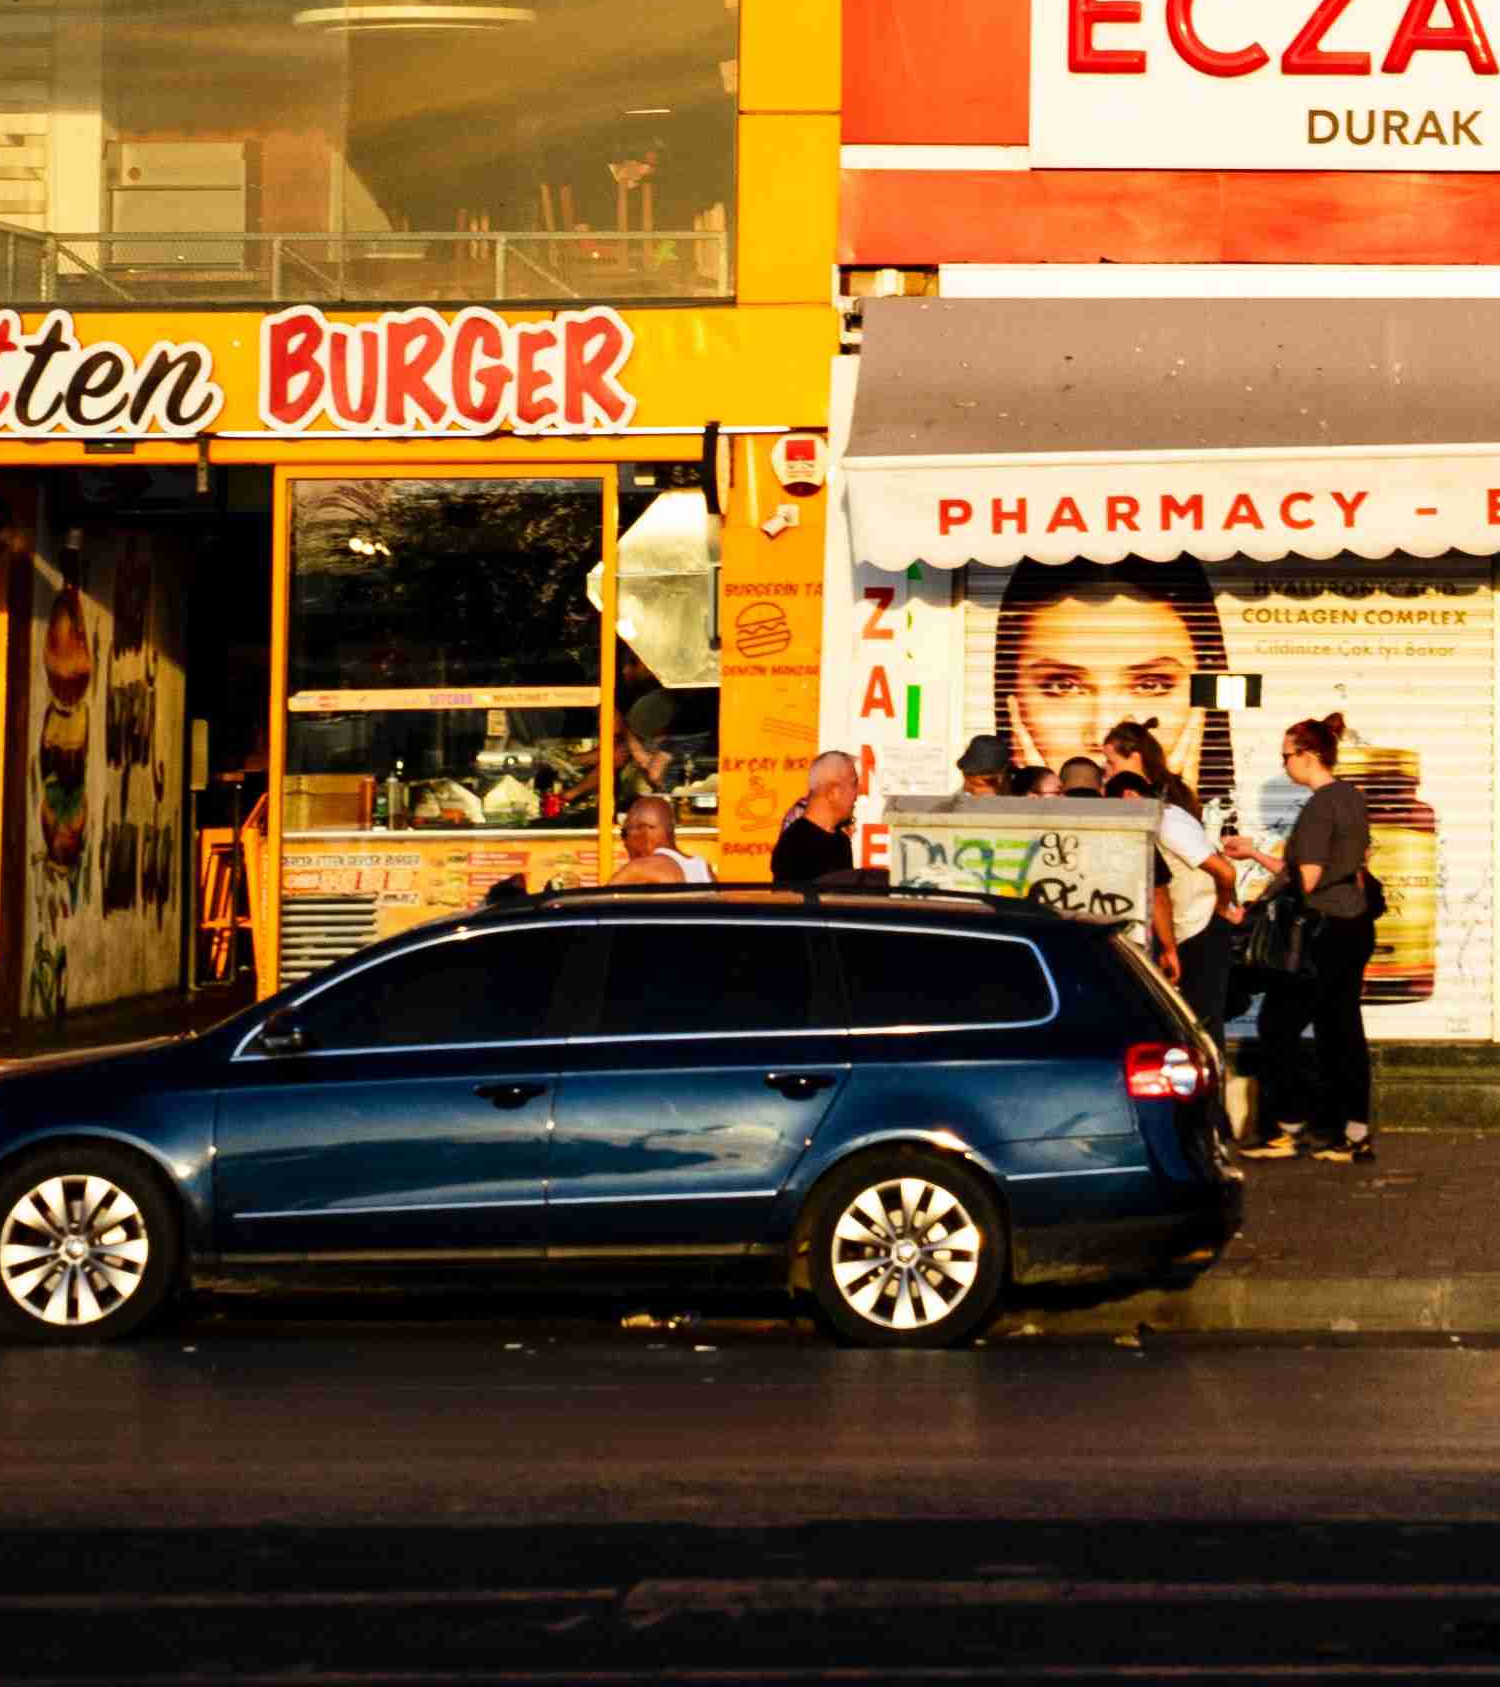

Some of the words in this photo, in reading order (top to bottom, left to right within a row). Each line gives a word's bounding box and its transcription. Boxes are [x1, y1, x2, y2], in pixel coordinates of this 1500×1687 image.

[1306, 108, 1483, 147] DURAK
[266, 310, 632, 428] BURGER
[937, 489, 1370, 536] PHARMACY
[1241, 607, 1358, 625] COLLAGEN
[1363, 609, 1468, 625] COMPLEX
